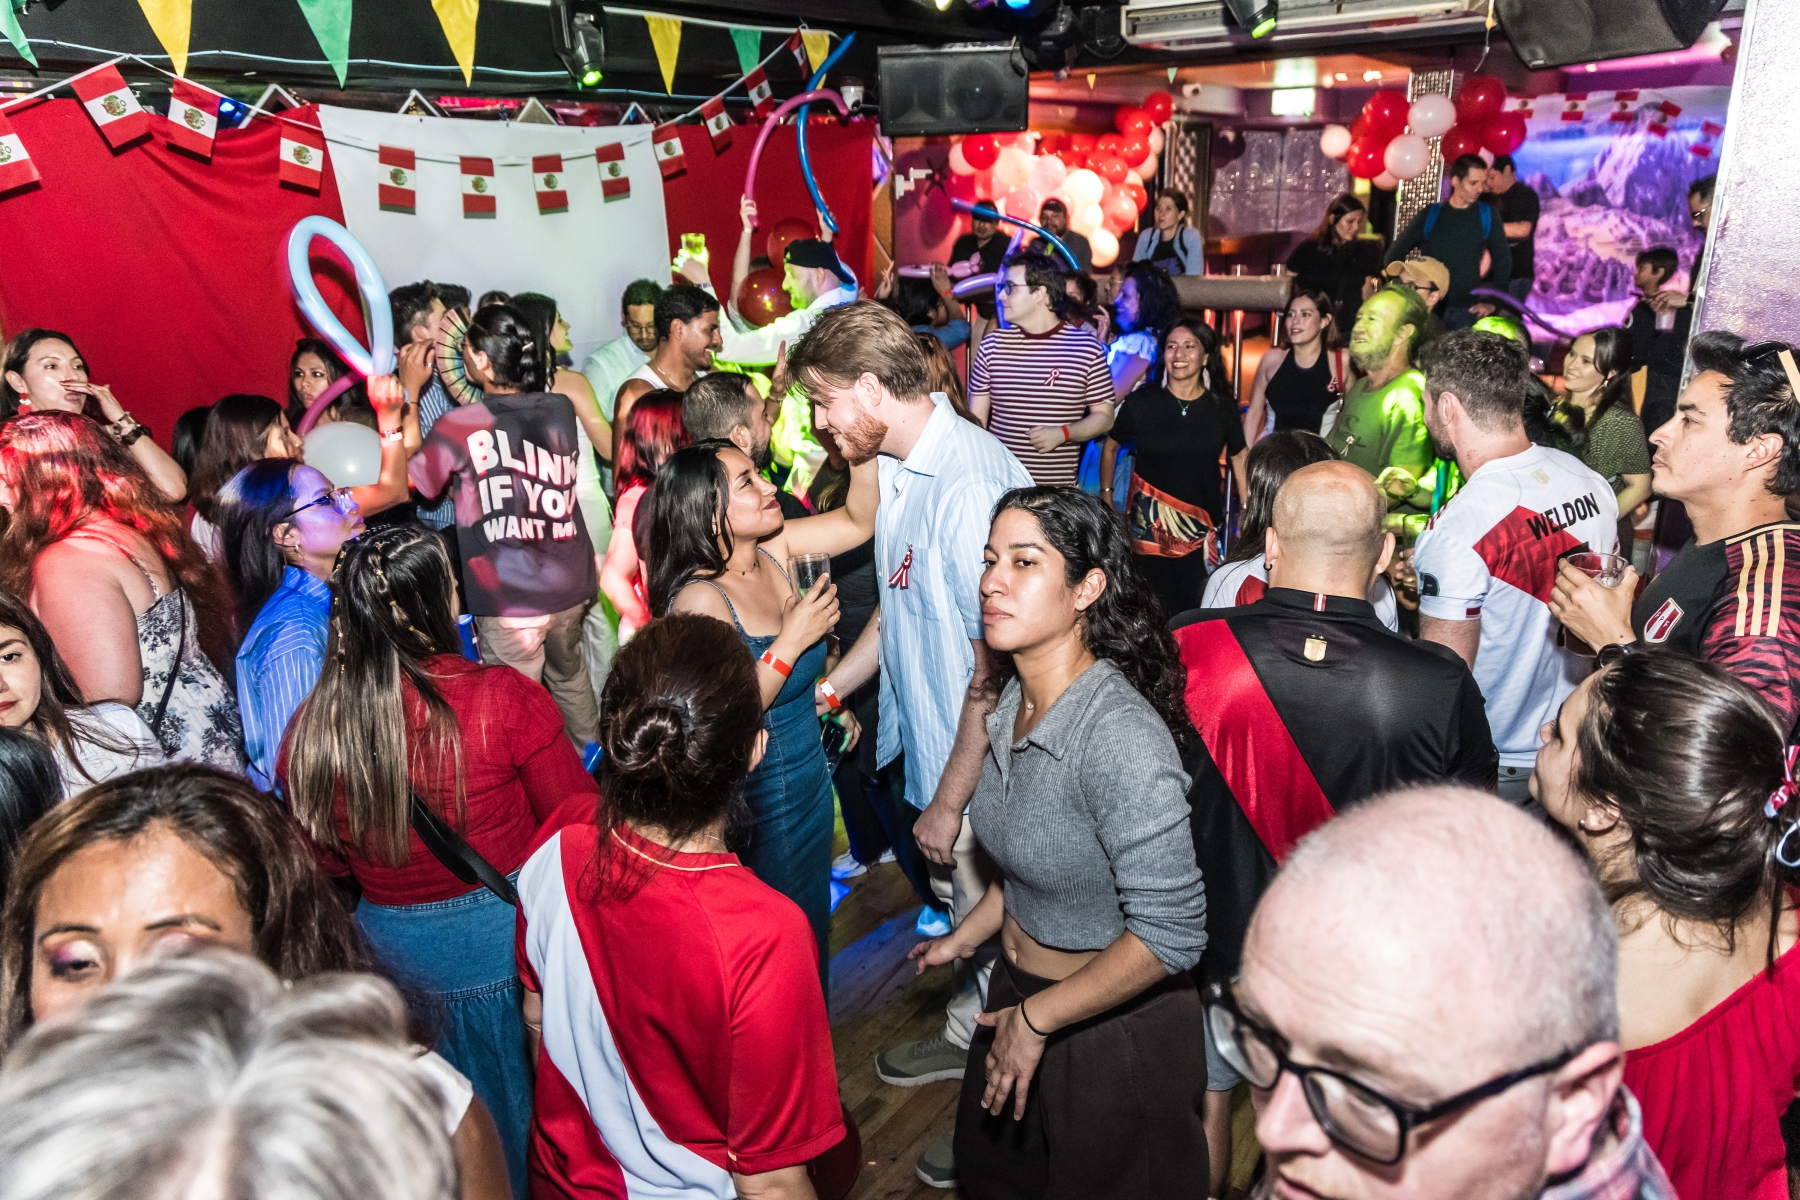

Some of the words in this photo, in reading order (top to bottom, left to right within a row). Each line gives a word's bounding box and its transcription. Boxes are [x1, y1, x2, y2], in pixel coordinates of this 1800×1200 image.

[478, 475, 513, 515] IF
[522, 478, 577, 518] YOU
[1526, 492, 1600, 541] WELDON
[483, 515, 546, 543] WANT
